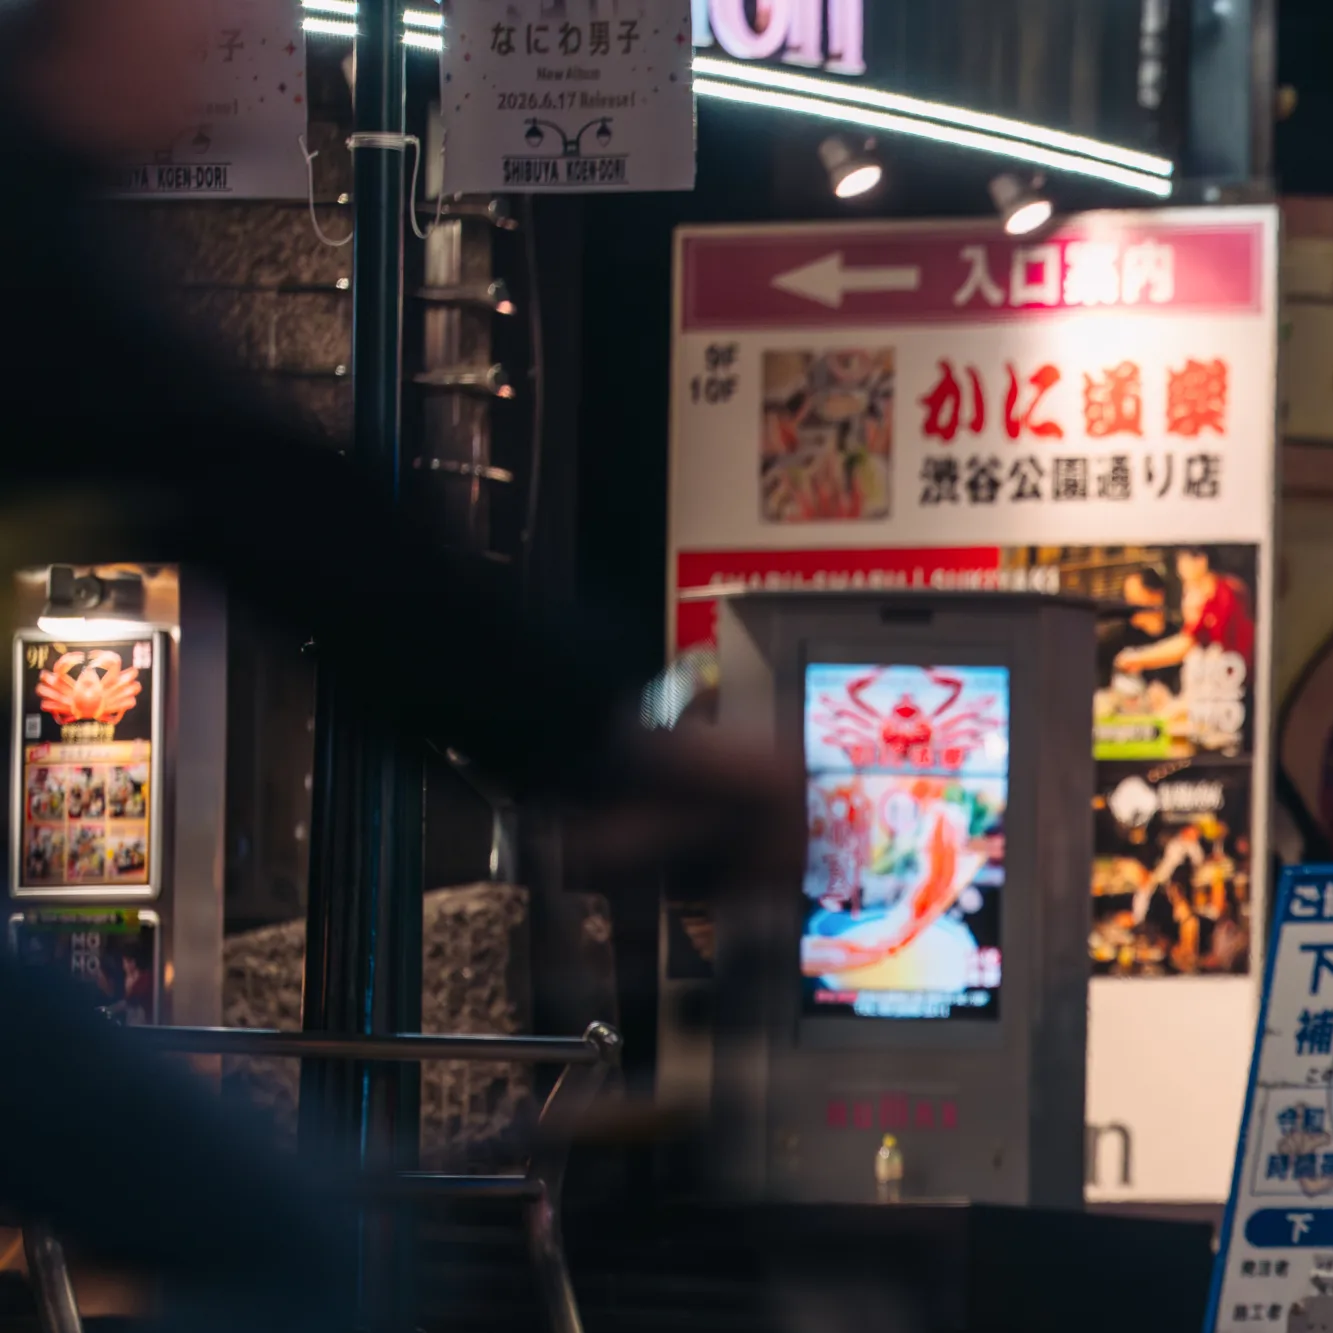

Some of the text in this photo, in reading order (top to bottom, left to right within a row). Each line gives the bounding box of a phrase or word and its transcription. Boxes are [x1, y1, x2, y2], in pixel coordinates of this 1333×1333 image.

[490, 20, 640, 57] なにわ男子
[537, 66, 563, 80] New
[497, 92, 576, 111] 2026.6.17
[157, 166, 228, 190] KOEN-DORI
[502, 157, 627, 183] SHIBUYA KOEN-DORI
[705, 342, 738, 372] 9F
[690, 376, 739, 405] 10F
[919, 454, 1222, 505] 渋谷公園通り店
